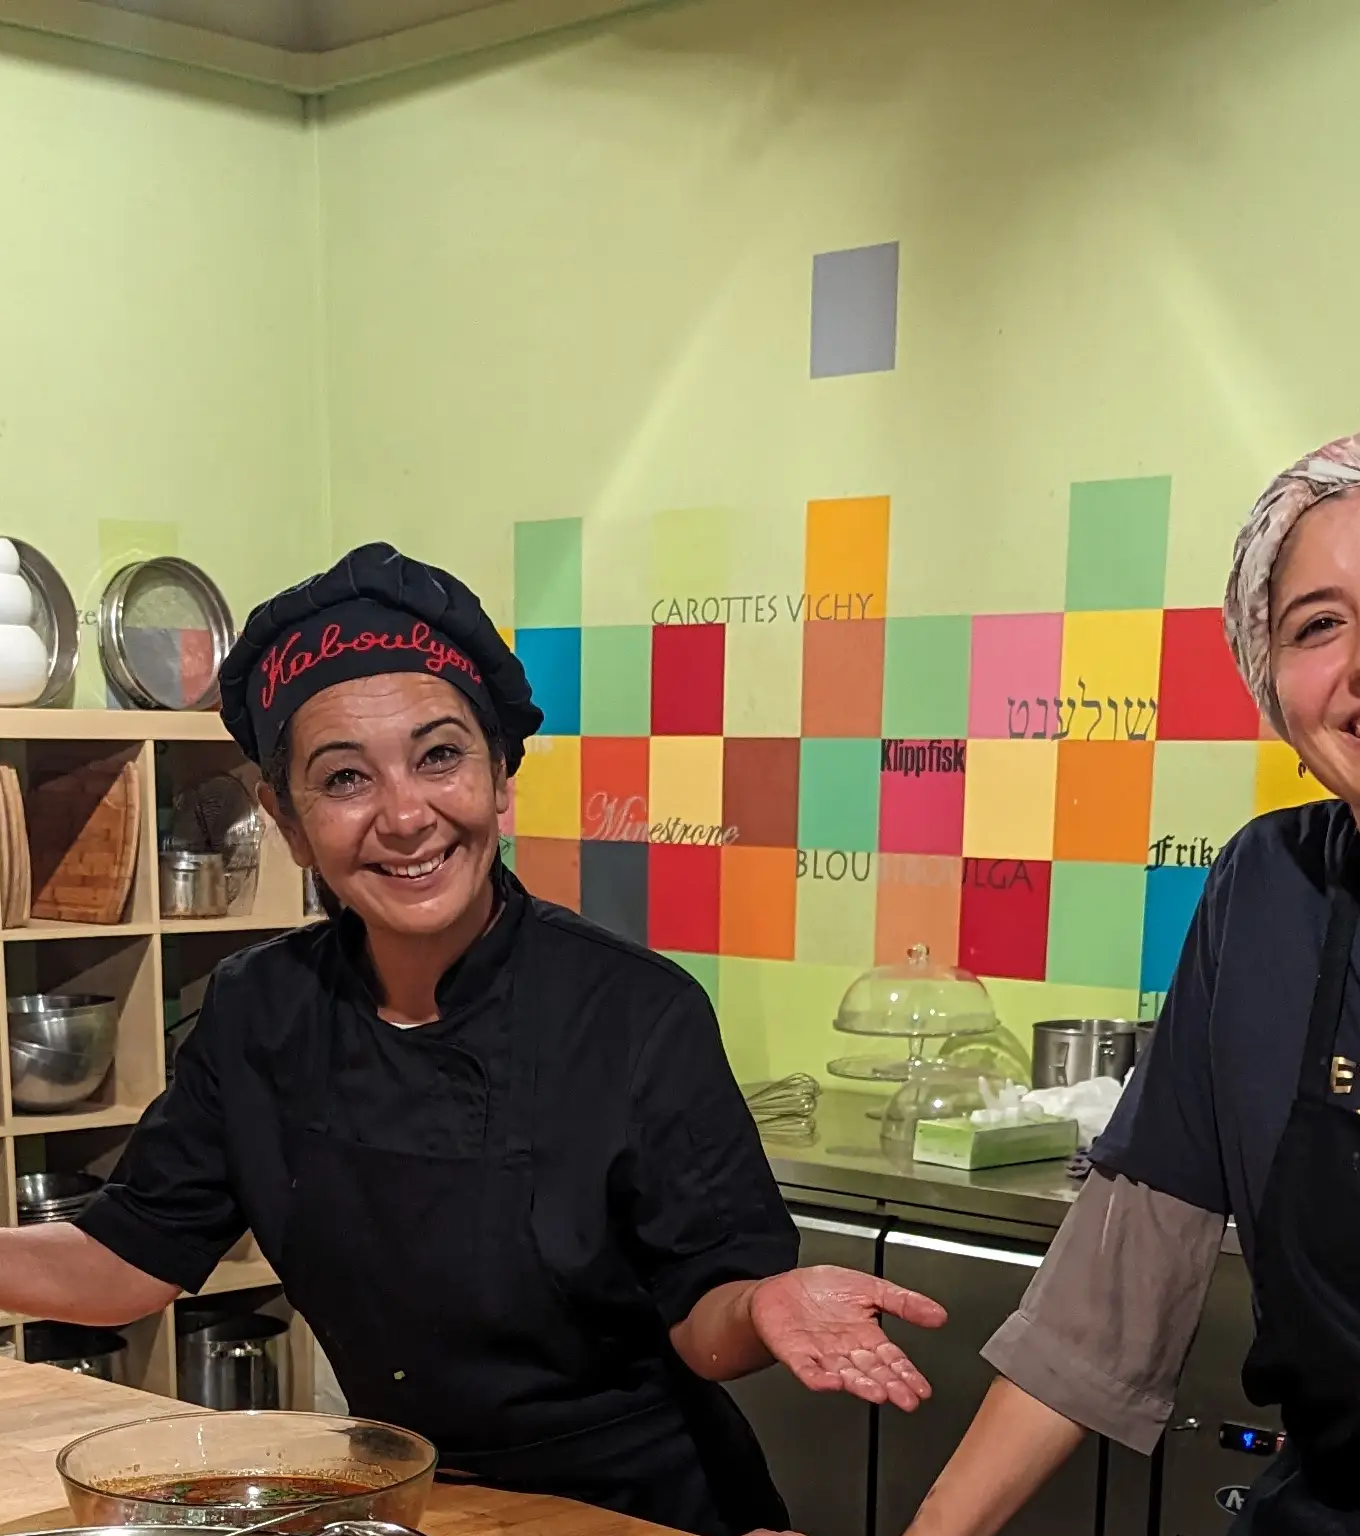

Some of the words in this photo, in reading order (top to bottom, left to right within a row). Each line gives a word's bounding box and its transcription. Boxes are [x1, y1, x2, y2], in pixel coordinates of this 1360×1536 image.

[651, 594, 778, 625] CAROTTES
[786, 593, 874, 621] VICHY
[881, 739, 966, 777] Klippfisk
[582, 791, 740, 846] Minestrone
[1144, 834, 1224, 872] Frik
